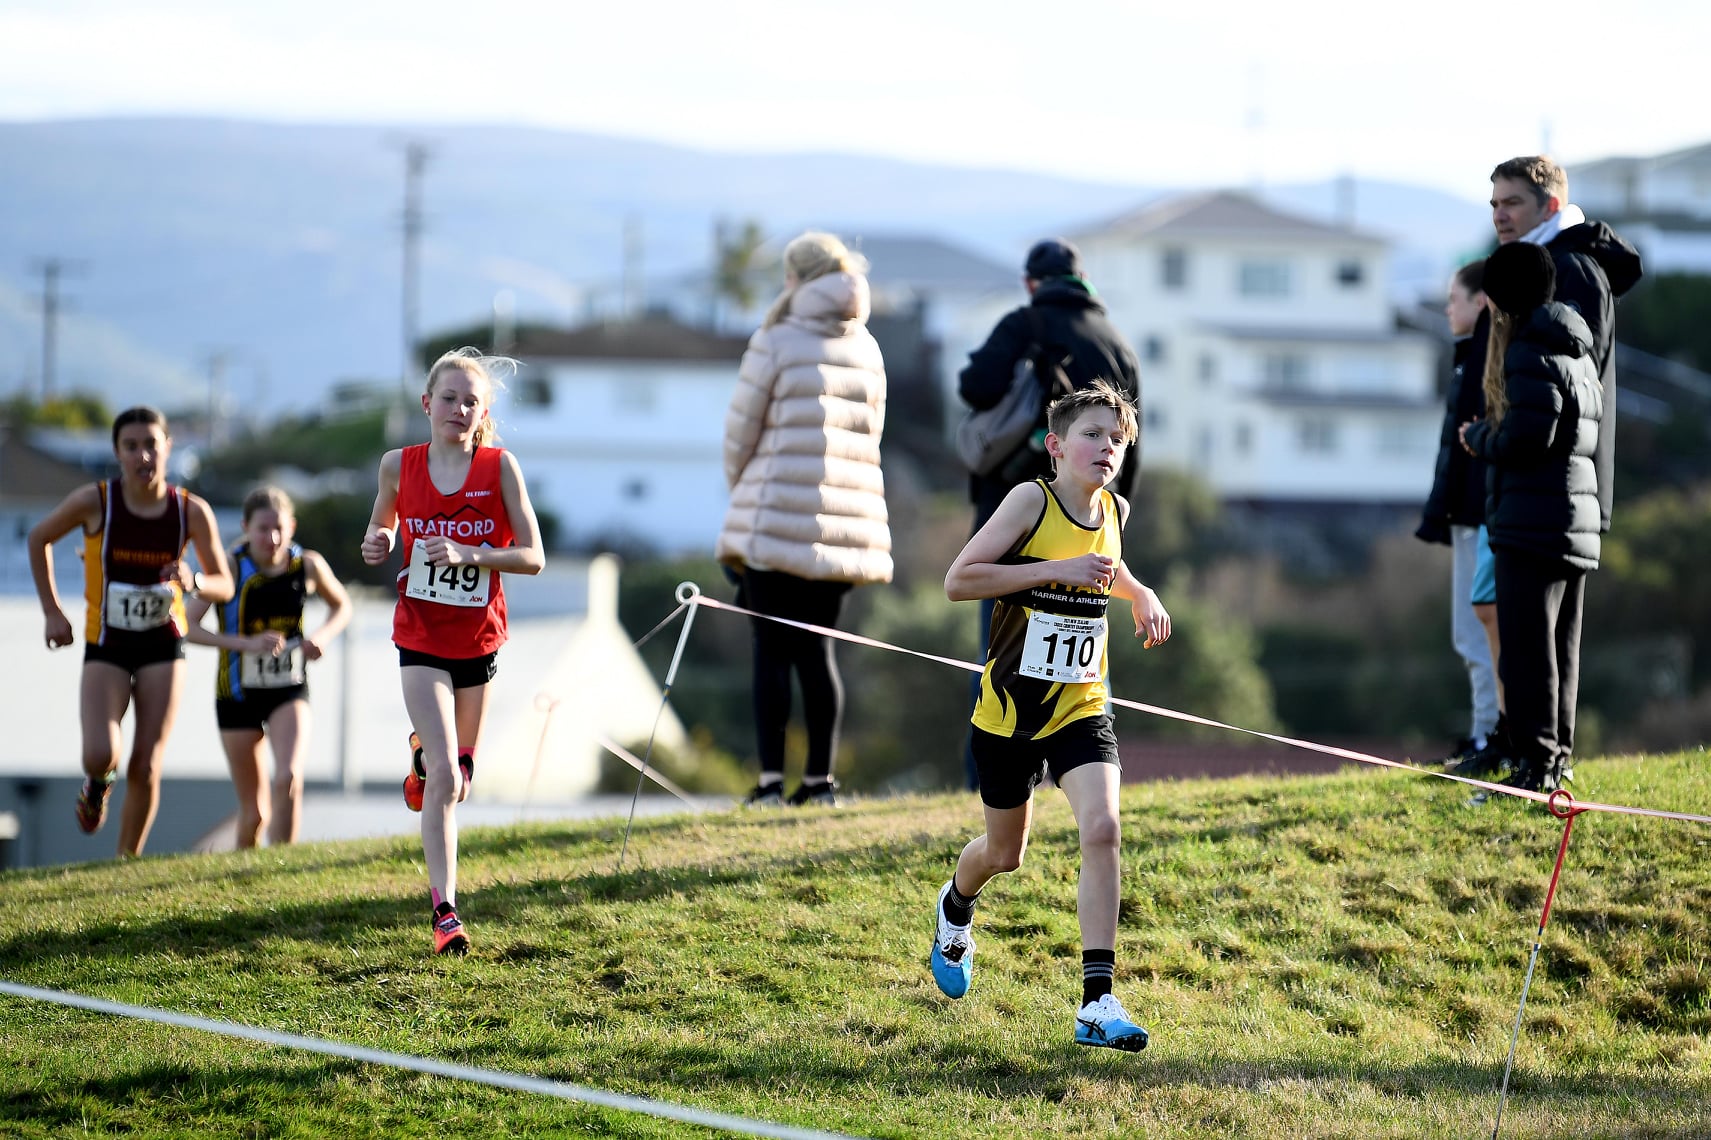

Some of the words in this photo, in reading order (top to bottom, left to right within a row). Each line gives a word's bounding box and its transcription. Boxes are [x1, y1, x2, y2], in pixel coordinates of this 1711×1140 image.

[424, 561, 480, 593] 149
[119, 597, 164, 619] 142
[1031, 589, 1068, 603] HARRIER
[1042, 632, 1095, 668] 110
